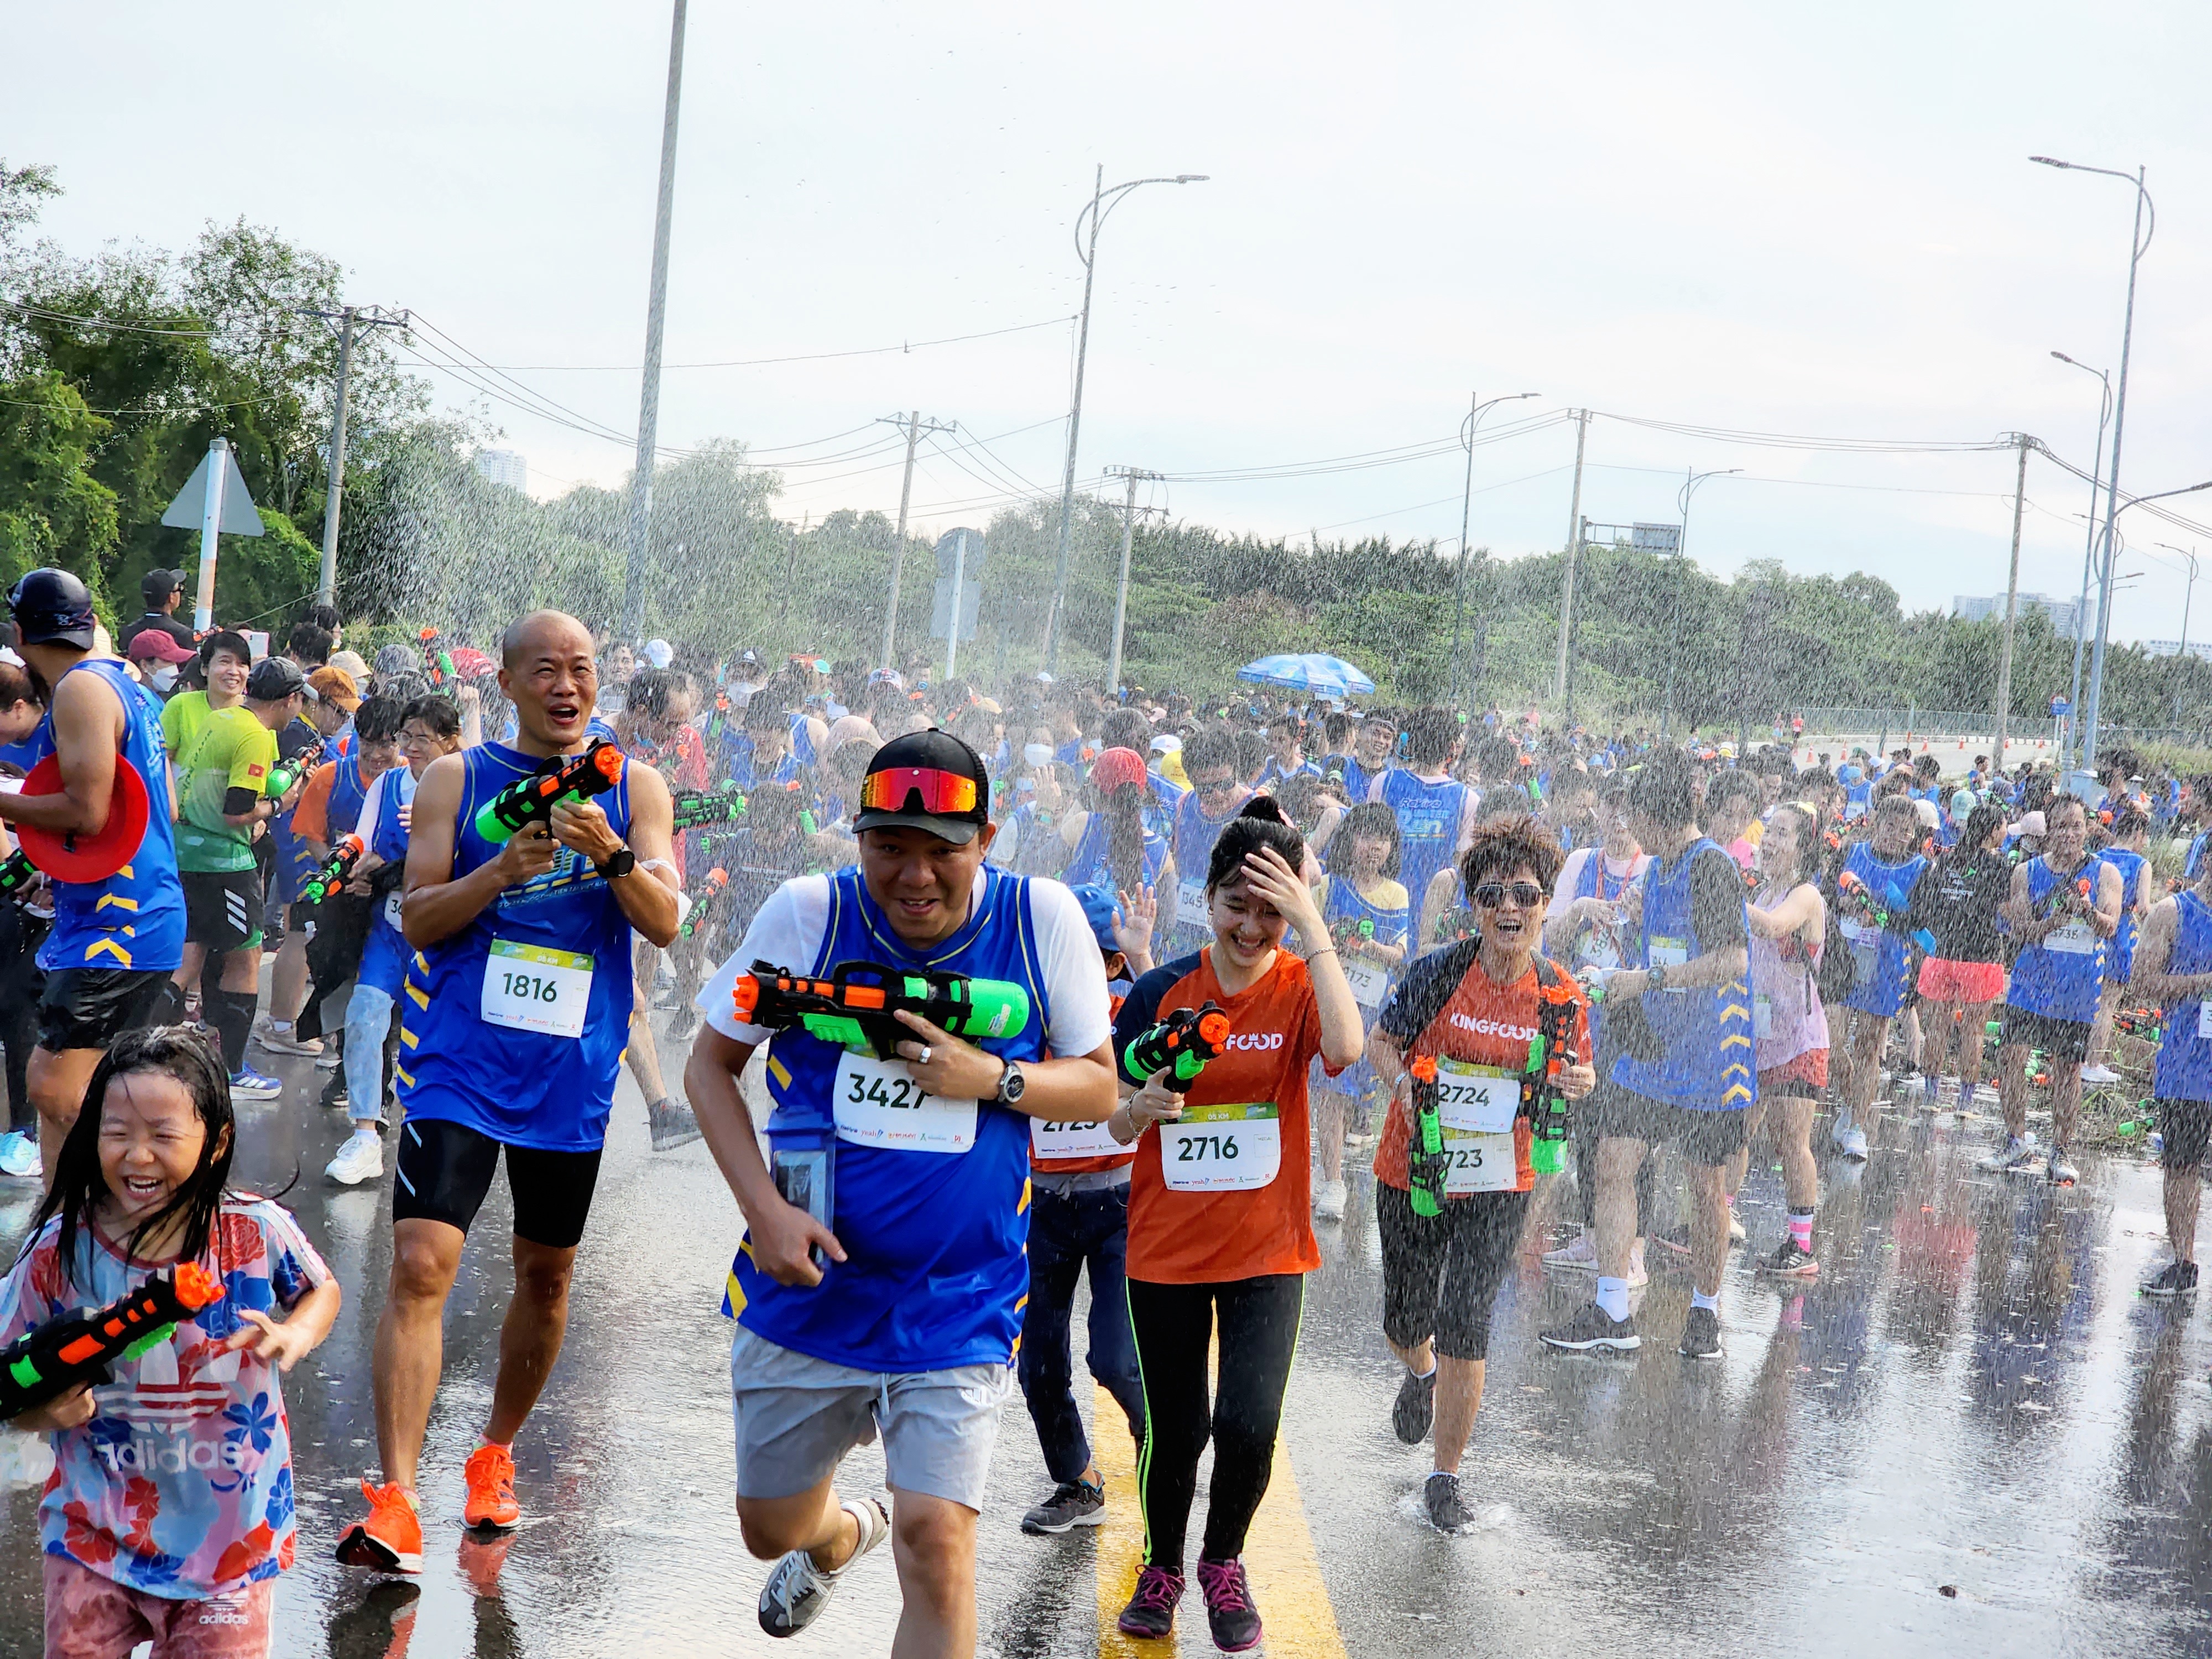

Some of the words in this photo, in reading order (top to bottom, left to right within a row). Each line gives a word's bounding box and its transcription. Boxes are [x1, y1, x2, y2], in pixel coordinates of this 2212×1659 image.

[503, 973, 557, 1003] 1816
[1449, 1013, 1538, 1041] KINGFOOD
[1226, 1032, 1283, 1050] FOOD
[1439, 1083, 1490, 1107] 2724
[1177, 1135, 1239, 1161] 2716
[199, 1612, 248, 1625] adidas
